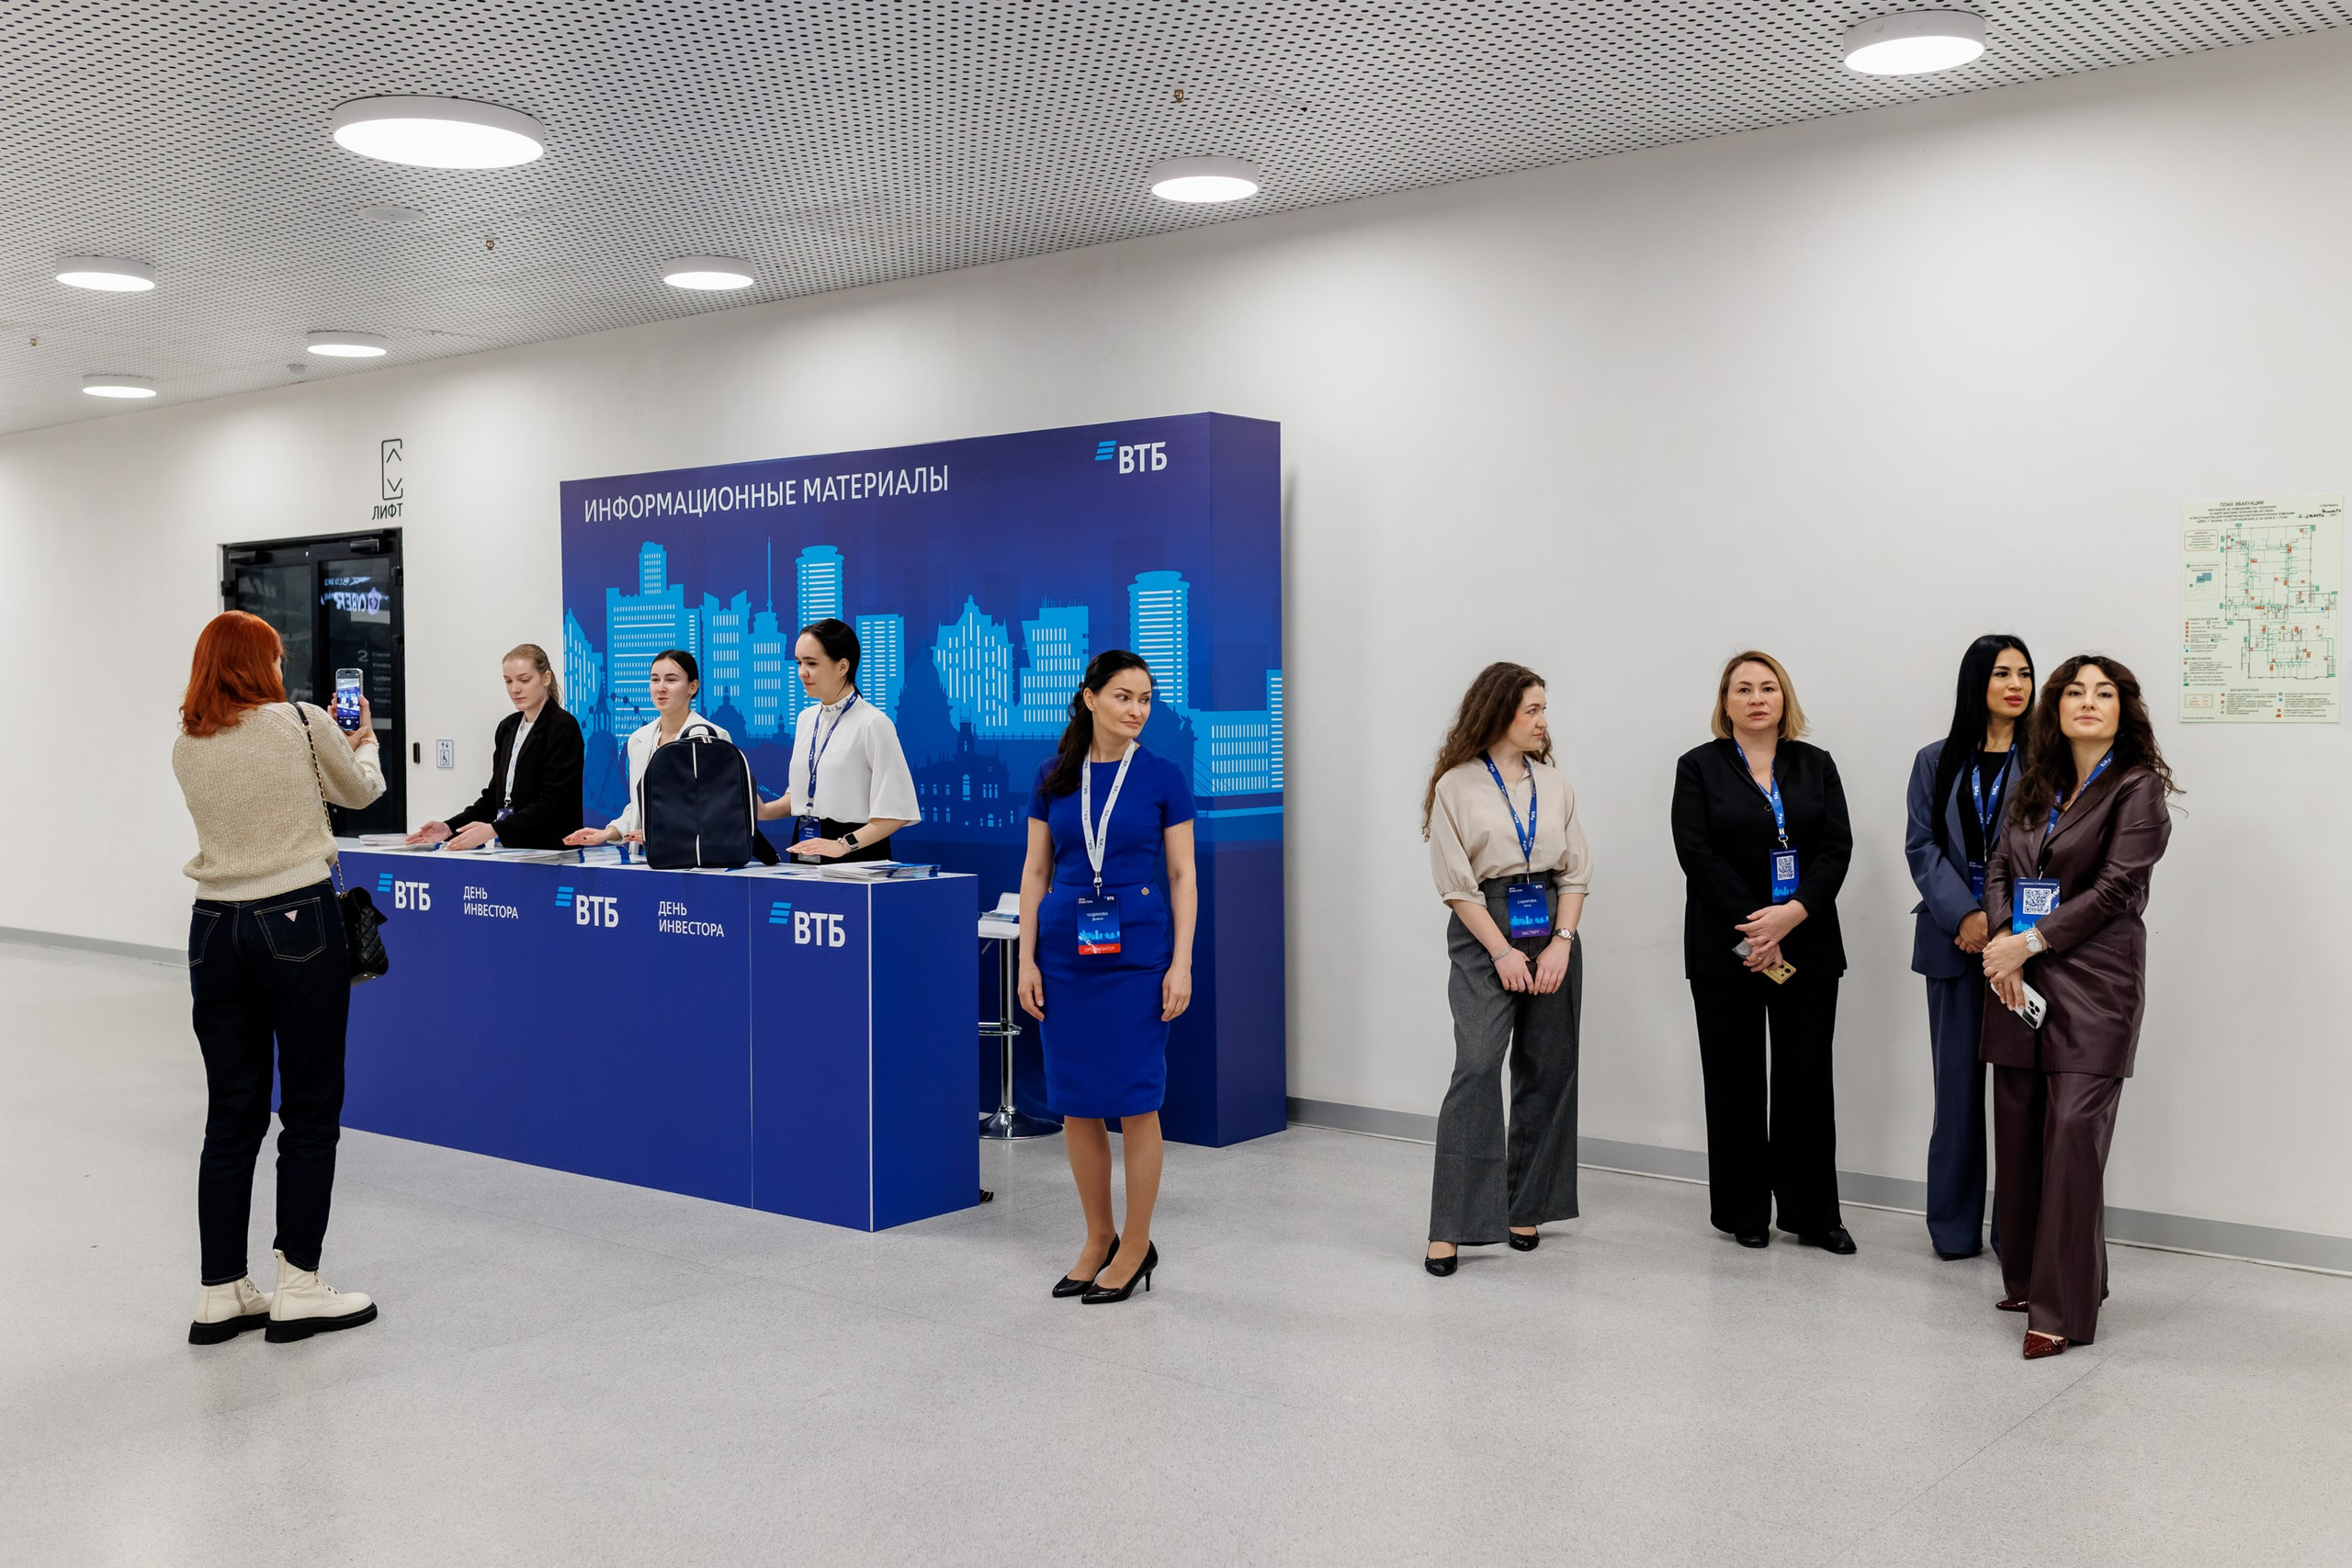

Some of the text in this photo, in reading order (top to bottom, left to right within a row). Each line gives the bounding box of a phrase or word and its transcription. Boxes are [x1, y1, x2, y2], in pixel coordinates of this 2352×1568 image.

[1119, 441, 1168, 475] ВТБ
[583, 464, 950, 523] ИНФОРМАЦИОННЫЕ МАТЕРИАЛЫ
[372, 502, 402, 521] ЛИФТ
[357, 649, 369, 663] 2
[394, 880, 432, 911] ВТБ
[463, 886, 488, 901] ДЕНЬ
[464, 902, 519, 919] ИНВЕСТОРА
[575, 894, 619, 928] ВТБ
[658, 900, 688, 918] ДЕНЬ
[659, 919, 725, 938] ИНВЕСТОРА
[794, 910, 846, 948] ВТБ
